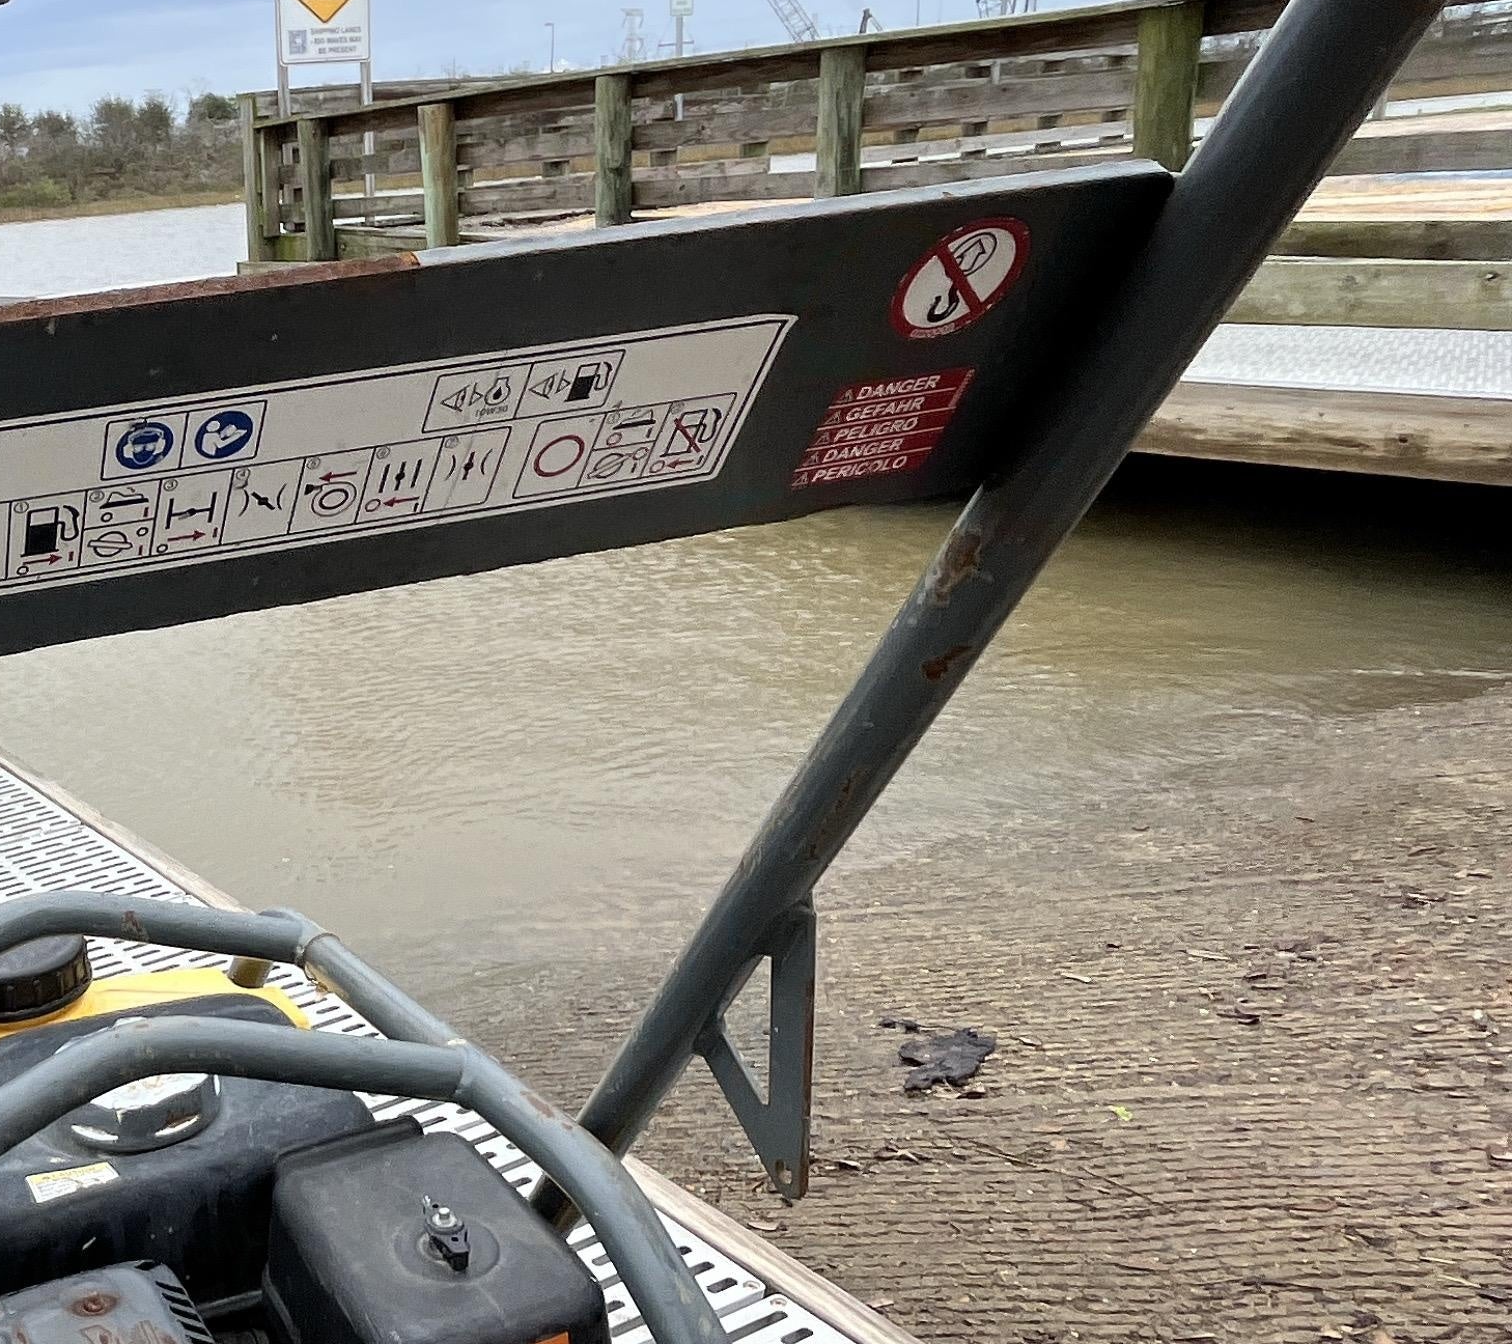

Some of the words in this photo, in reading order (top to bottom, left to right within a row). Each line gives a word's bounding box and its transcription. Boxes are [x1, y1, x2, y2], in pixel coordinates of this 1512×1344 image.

[855, 374, 941, 400] DANGER
[845, 396, 926, 422] GEFAHR
[833, 416, 920, 443] PELIGRO
[821, 438, 904, 463] DANGER
[811, 455, 908, 483] PERICOLO
